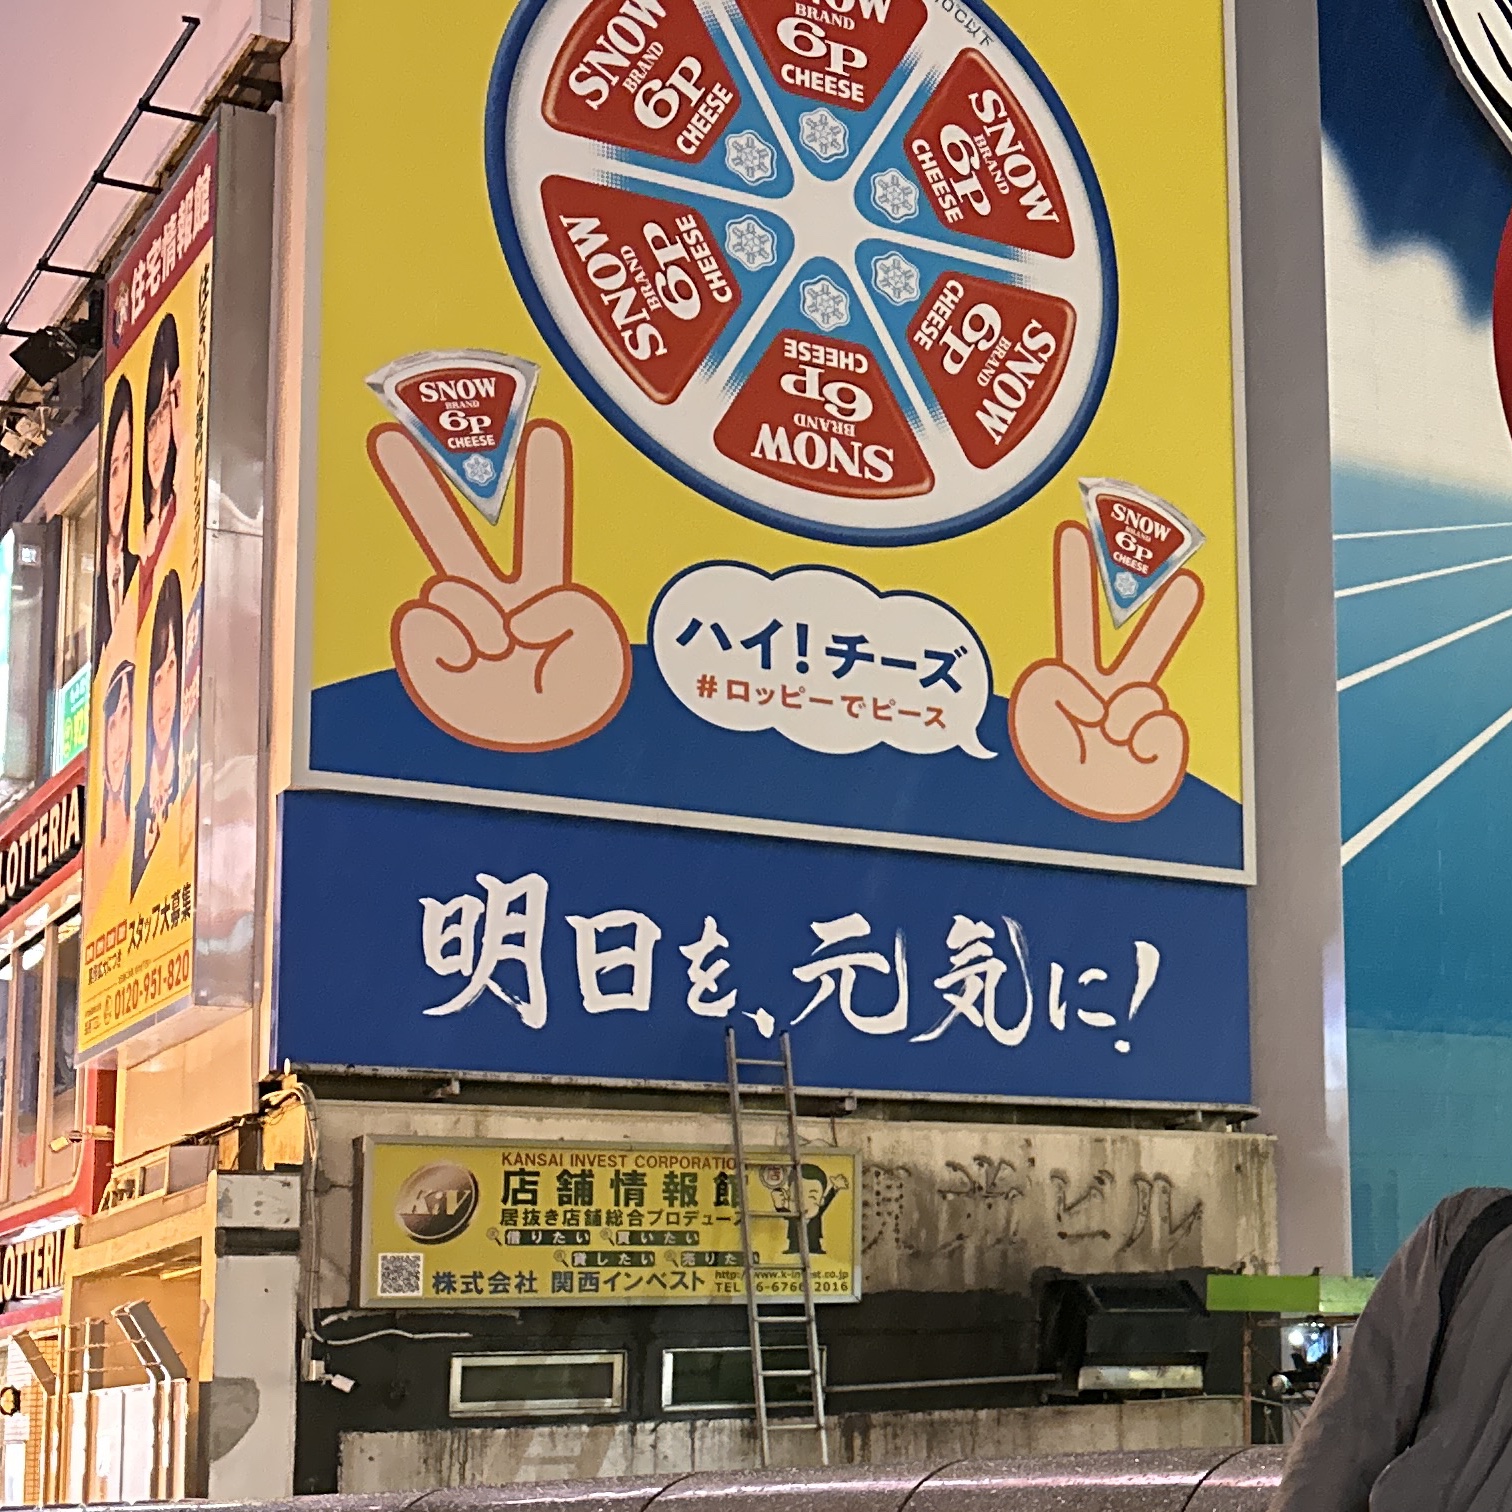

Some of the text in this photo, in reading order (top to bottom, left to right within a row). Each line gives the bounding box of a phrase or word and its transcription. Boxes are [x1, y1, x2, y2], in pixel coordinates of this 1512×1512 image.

[569, 0, 667, 110] SNOW
[776, 17, 868, 77] 6P
[634, 56, 705, 129] 6P
[781, 63, 864, 103] CHEESE
[676, 82, 733, 155] CHEESE
[911, 139, 963, 224] CHEESE
[939, 123, 991, 217] 6P
[968, 88, 1059, 225] SNOW
[560, 214, 668, 362] SNOW
[645, 221, 702, 321] 6P
[676, 213, 733, 304] CHEESE
[913, 278, 964, 351] CHEESE
[941, 304, 1003, 377] 6P
[783, 339, 869, 373] CHEESE
[975, 319, 1058, 447] SNOW
[419, 377, 496, 402] SNOW
[780, 365, 874, 423] 6P
[438, 410, 492, 434] 6P
[448, 434, 496, 449] CHEESE
[751, 423, 896, 483] SNOW
[1110, 503, 1171, 542] SNOW
[1115, 531, 1153, 562] 6P
[1113, 551, 1149, 574] CHEESE
[501, 1152, 748, 1171] KANSAI INVEST CORPORATIO
[0, 1229, 66, 1300] OTTERI
[432, 1270, 705, 1294] 株式会社 関西インベスト
[716, 1281, 849, 1293] TEL 6-6762016
